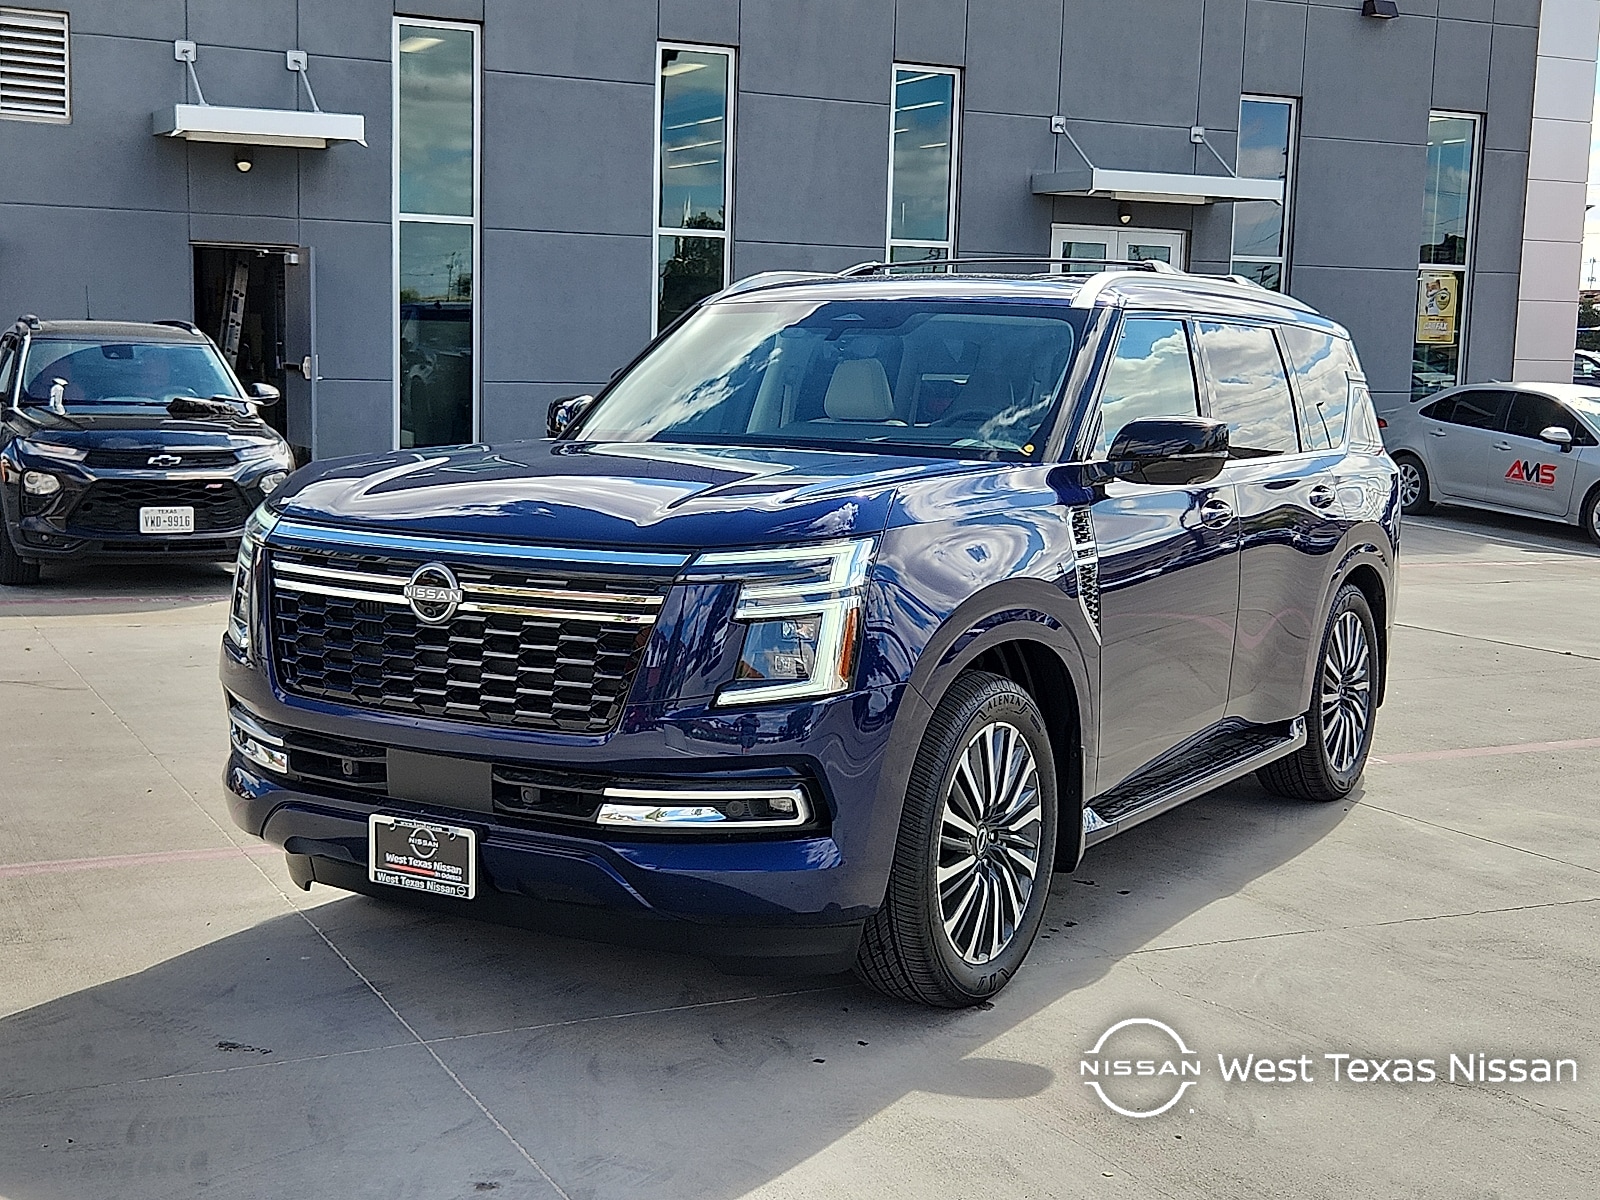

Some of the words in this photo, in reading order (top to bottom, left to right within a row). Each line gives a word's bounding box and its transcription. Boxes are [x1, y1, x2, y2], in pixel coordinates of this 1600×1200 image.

[1505, 459, 1558, 485] AMS
[404, 586, 461, 601] NISSAN
[987, 694, 1021, 712] ALENZA
[408, 837, 439, 848] NISSAN
[385, 852, 408, 865] West
[408, 856, 433, 870] Texas
[433, 861, 462, 875] Nissan
[376, 872, 400, 884] West
[400, 876, 425, 889] Texas
[426, 881, 456, 895] Nissan
